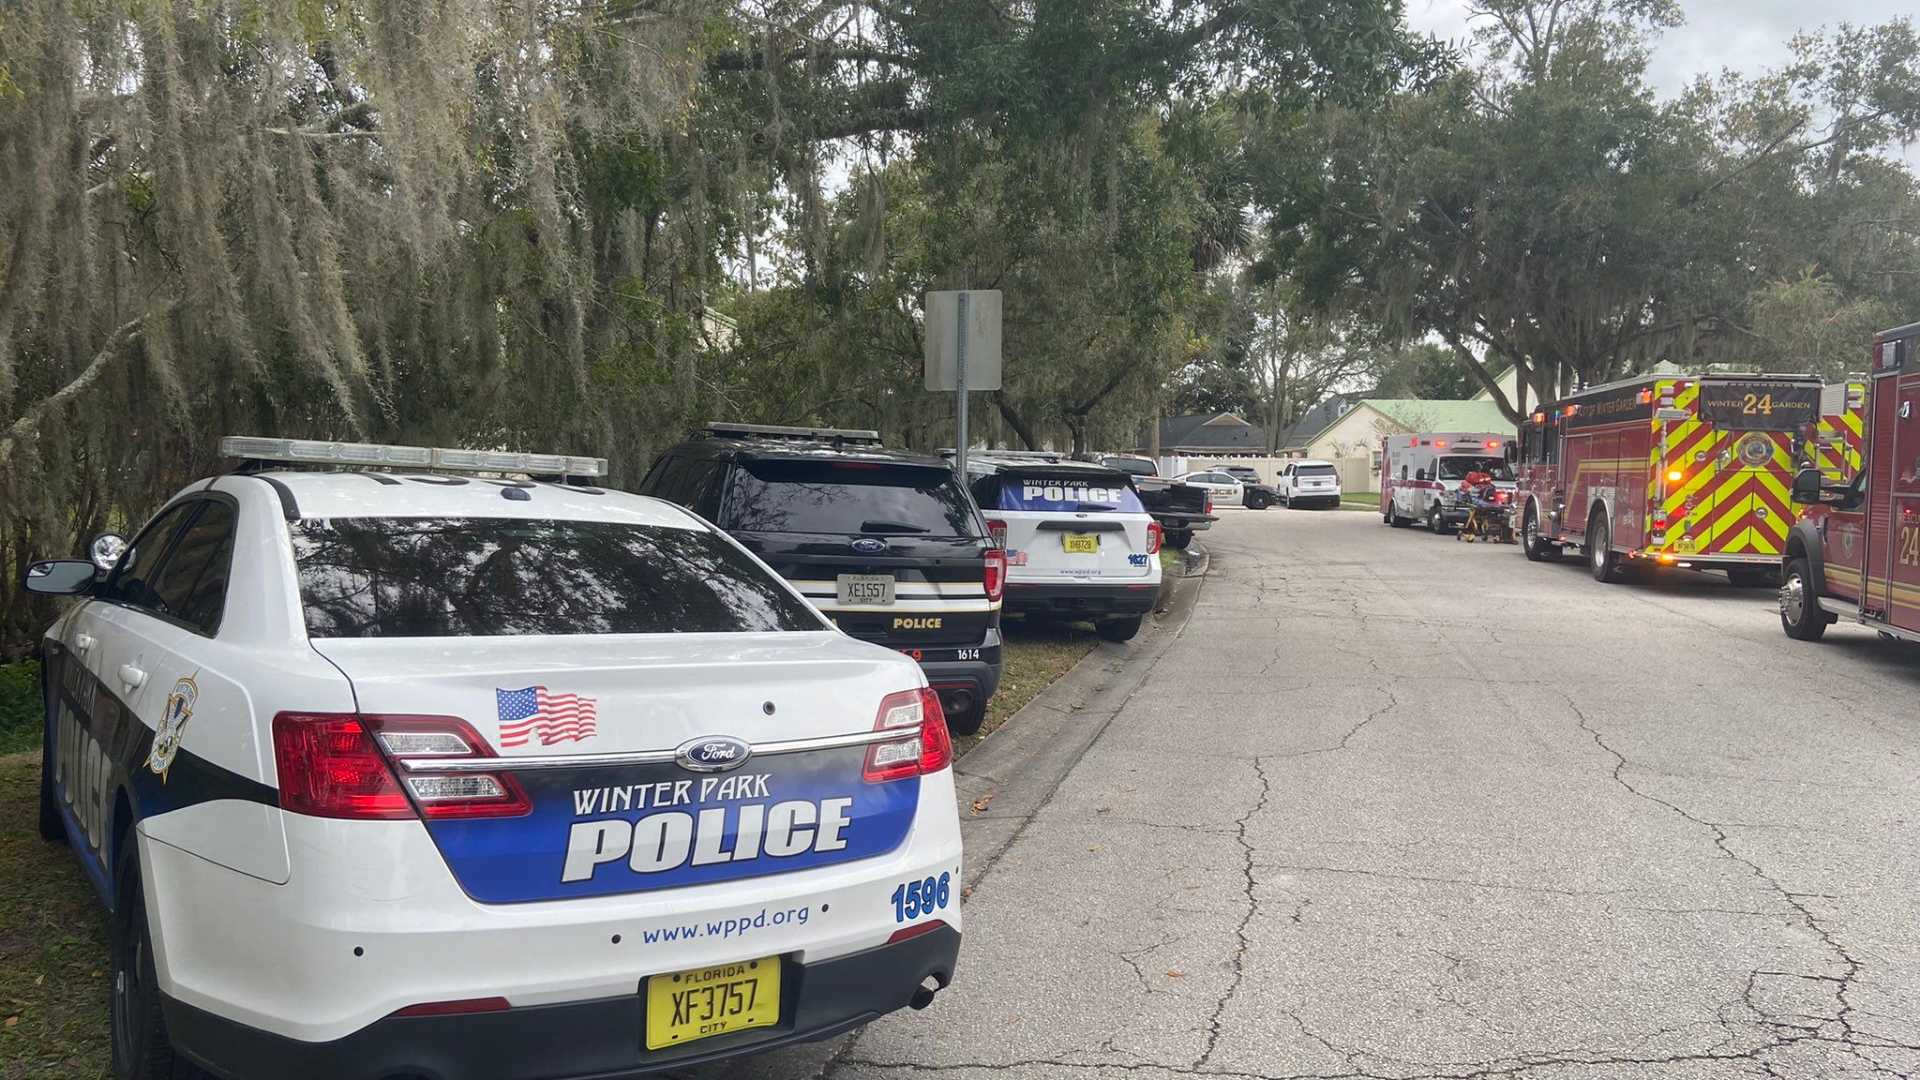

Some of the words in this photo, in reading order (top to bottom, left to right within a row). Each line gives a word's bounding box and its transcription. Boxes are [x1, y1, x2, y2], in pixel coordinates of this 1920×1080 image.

[1743, 393, 1772, 415] 24
[1772, 401, 1811, 409] GARDEN
[1023, 486, 1122, 503] POLICE
[1900, 526, 1919, 566] 24
[847, 583, 886, 597] XE1557
[893, 618, 942, 629] POLICE
[957, 649, 979, 660] 1614
[701, 745, 736, 761] Ford
[573, 779, 692, 815] WINTER
[700, 773, 771, 803] PARK
[560, 797, 853, 884] POLICE
[891, 872, 950, 923] 1596
[643, 905, 809, 944] www.wppd.org
[685, 966, 746, 984] FLORIDA
[671, 979, 759, 1027] XF3757
[700, 1022, 728, 1034] CITY
